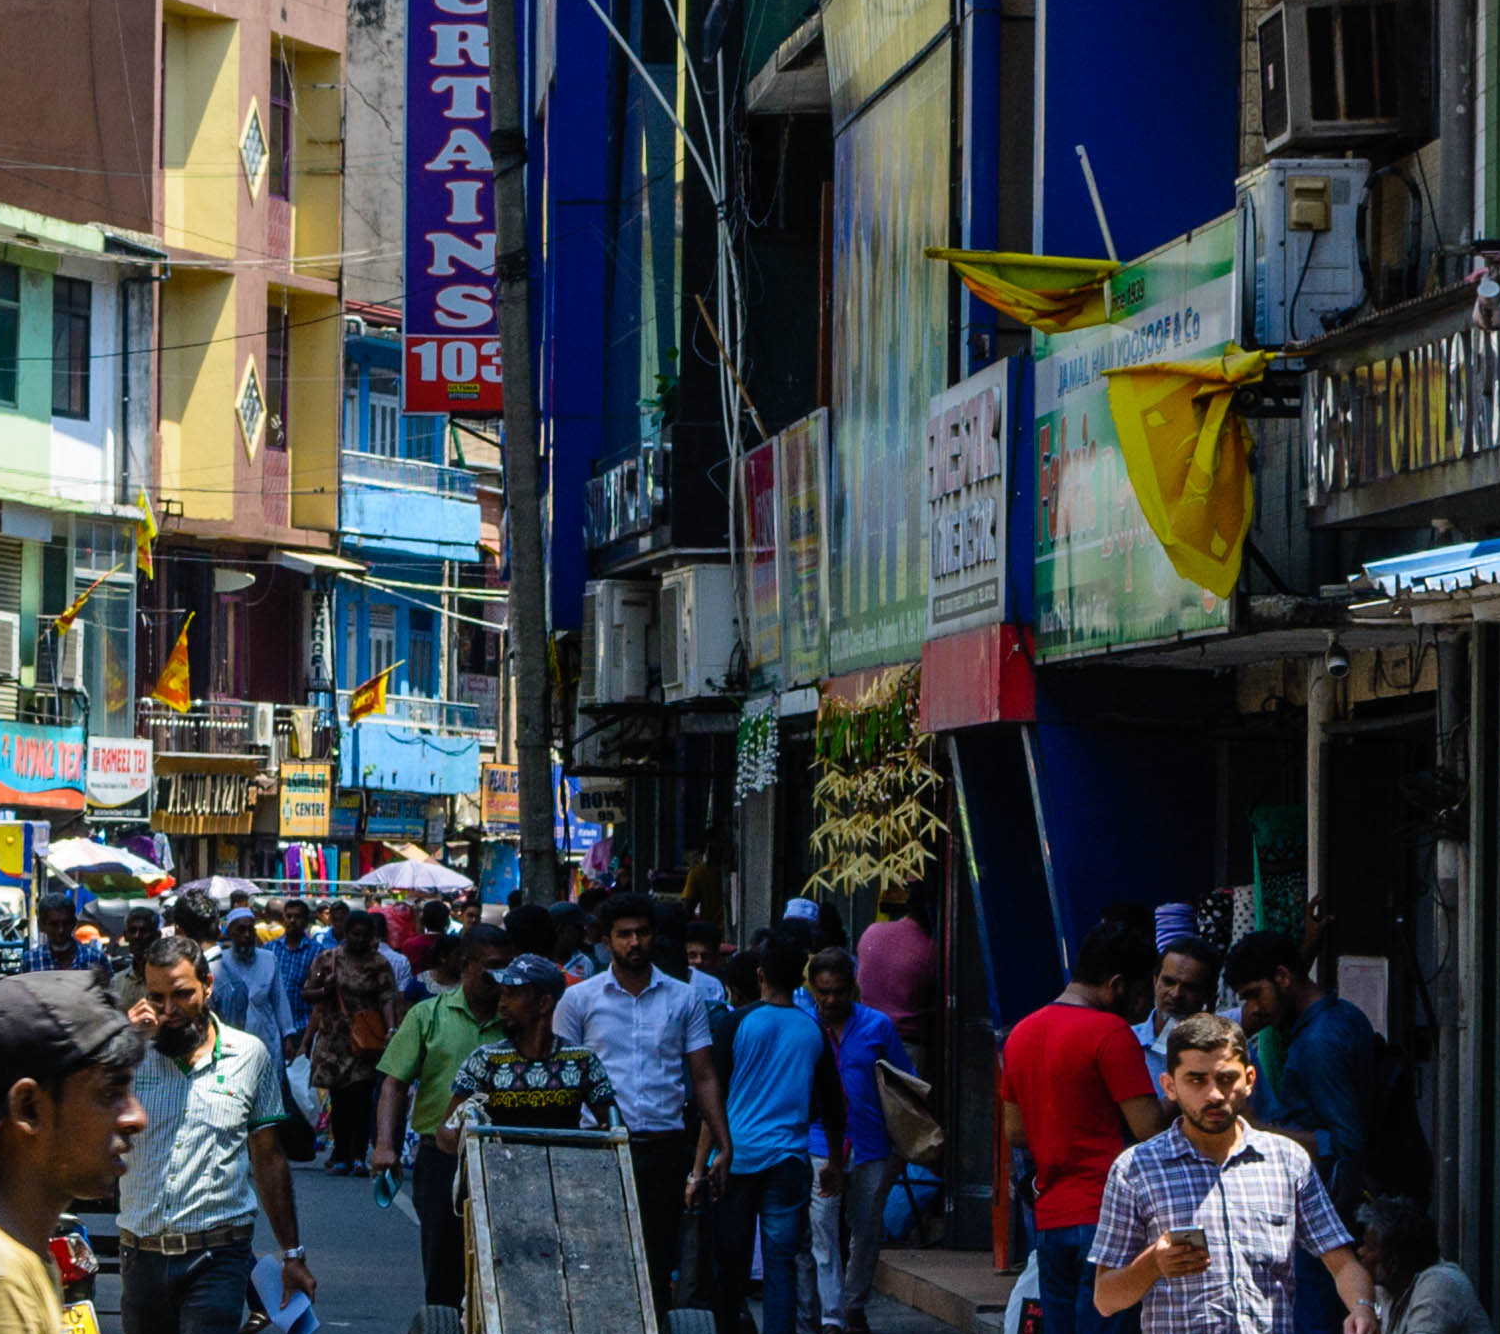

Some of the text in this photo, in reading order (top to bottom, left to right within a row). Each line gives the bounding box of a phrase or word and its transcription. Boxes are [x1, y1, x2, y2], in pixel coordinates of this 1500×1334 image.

[14, 735, 87, 782] RIYAZ TEX
[294, 802, 326, 817] CENTRE
